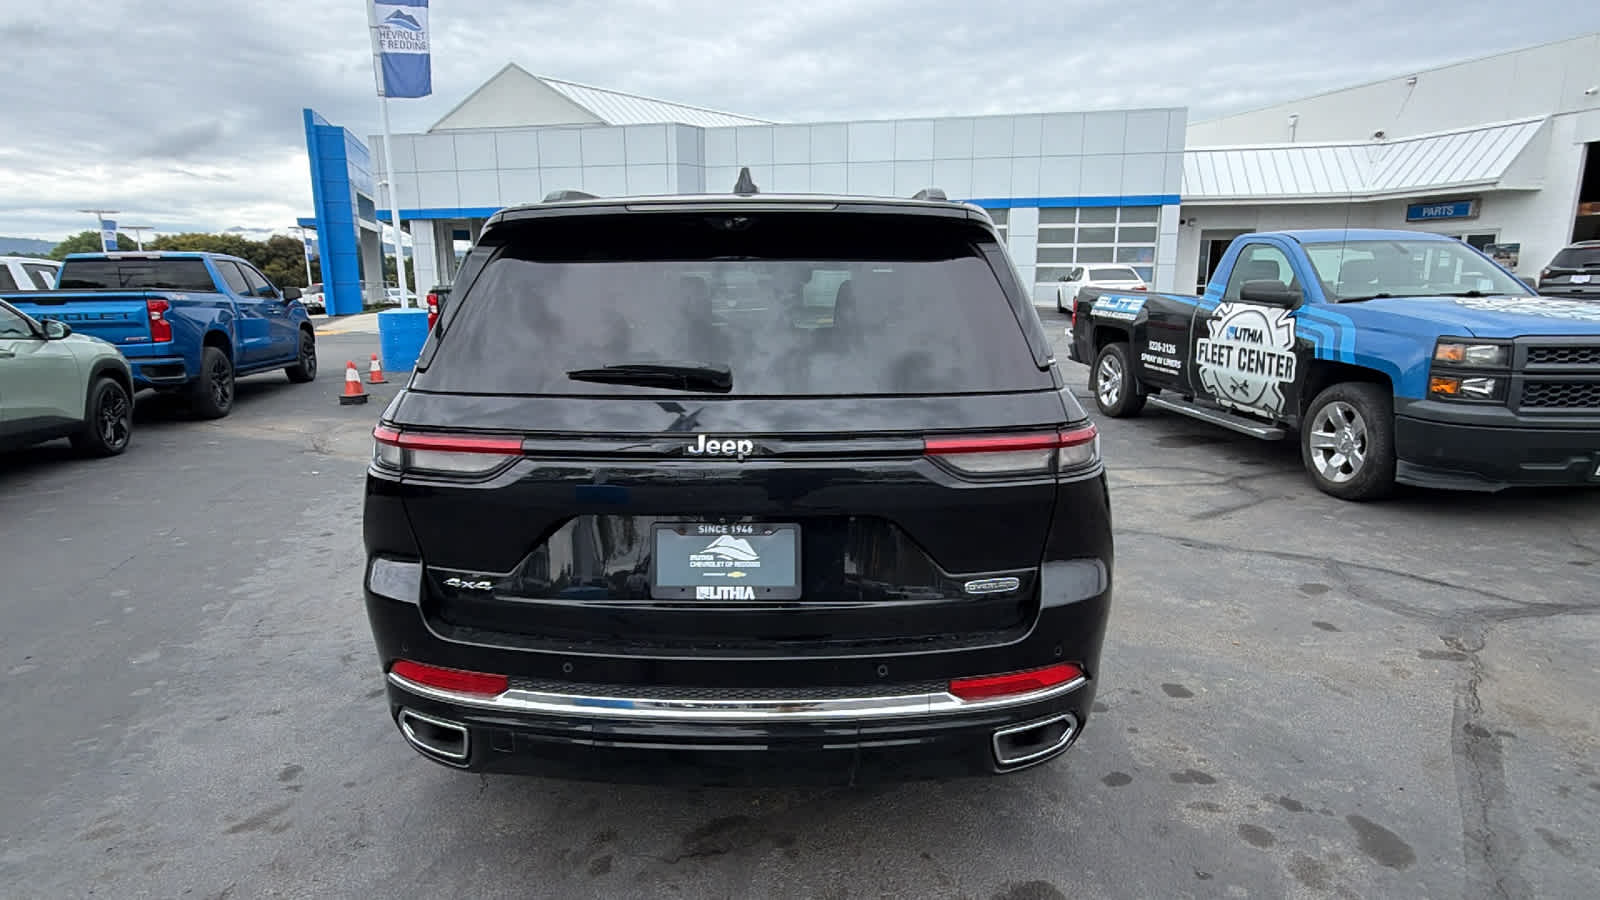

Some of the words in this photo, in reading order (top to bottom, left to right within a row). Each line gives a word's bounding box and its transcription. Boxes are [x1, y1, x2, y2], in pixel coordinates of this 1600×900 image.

[378, 30, 426, 41] HEVROLET
[378, 40, 386, 49] F
[388, 40, 427, 50] REDDING
[1422, 205, 1455, 217] PARTS
[1095, 296, 1145, 310] ELITE
[1234, 326, 1263, 345] LITHIA
[1197, 342, 1234, 369] FLEET
[1237, 347, 1294, 380] CENTER
[687, 434, 753, 460] Jeep
[698, 524, 727, 534] SINCE
[731, 524, 753, 534] 1946
[709, 586, 756, 600] LITHIA
